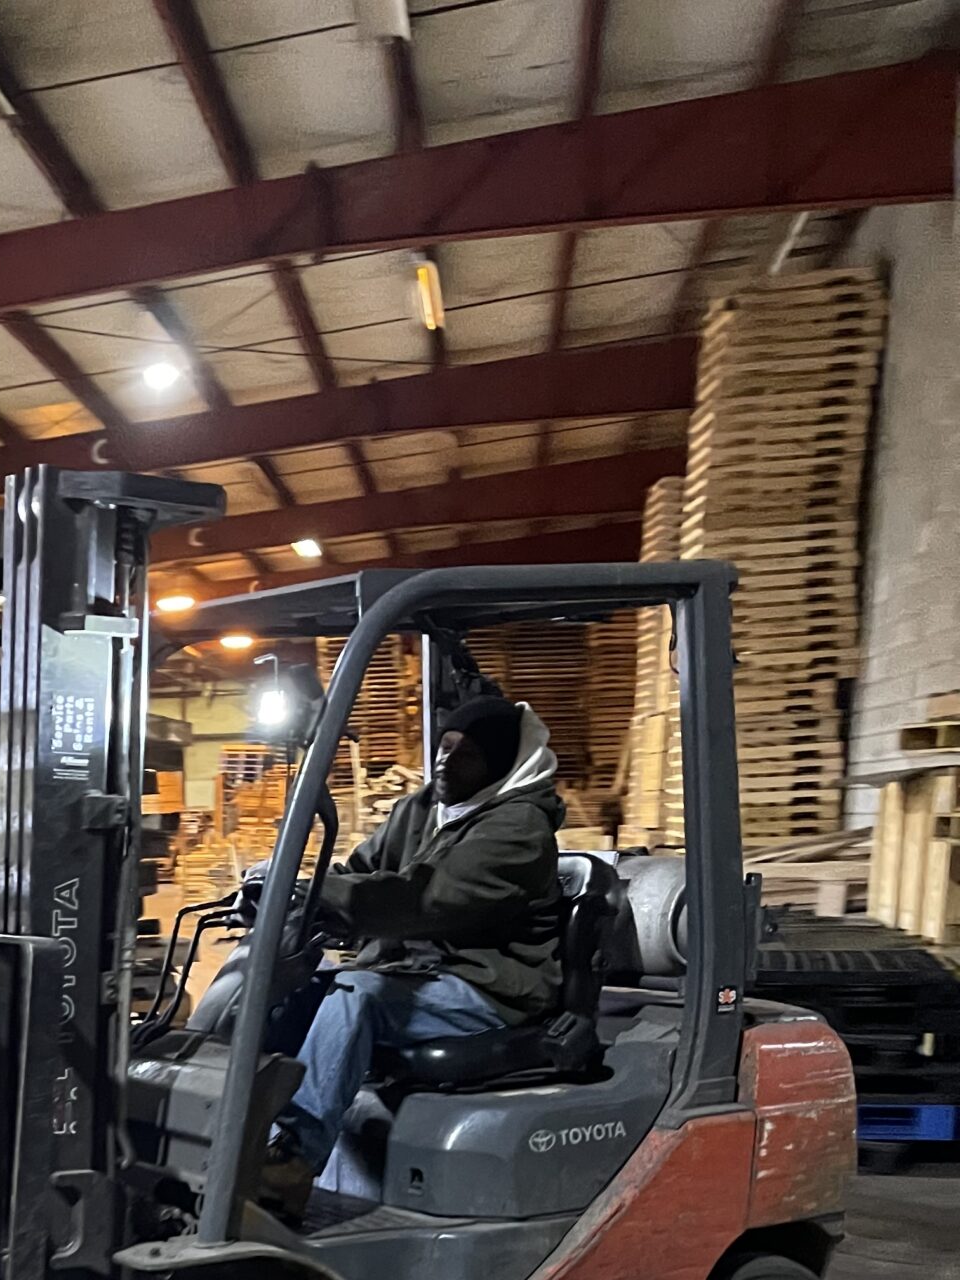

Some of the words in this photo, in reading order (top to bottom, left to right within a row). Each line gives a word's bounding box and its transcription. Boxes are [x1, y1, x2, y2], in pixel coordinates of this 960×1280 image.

[91, 438, 109, 464] C
[52, 695, 64, 747] Service
[64, 695, 75, 733] Parts
[84, 698, 94, 743] Rental
[559, 1121, 627, 1146] TOYOTA
